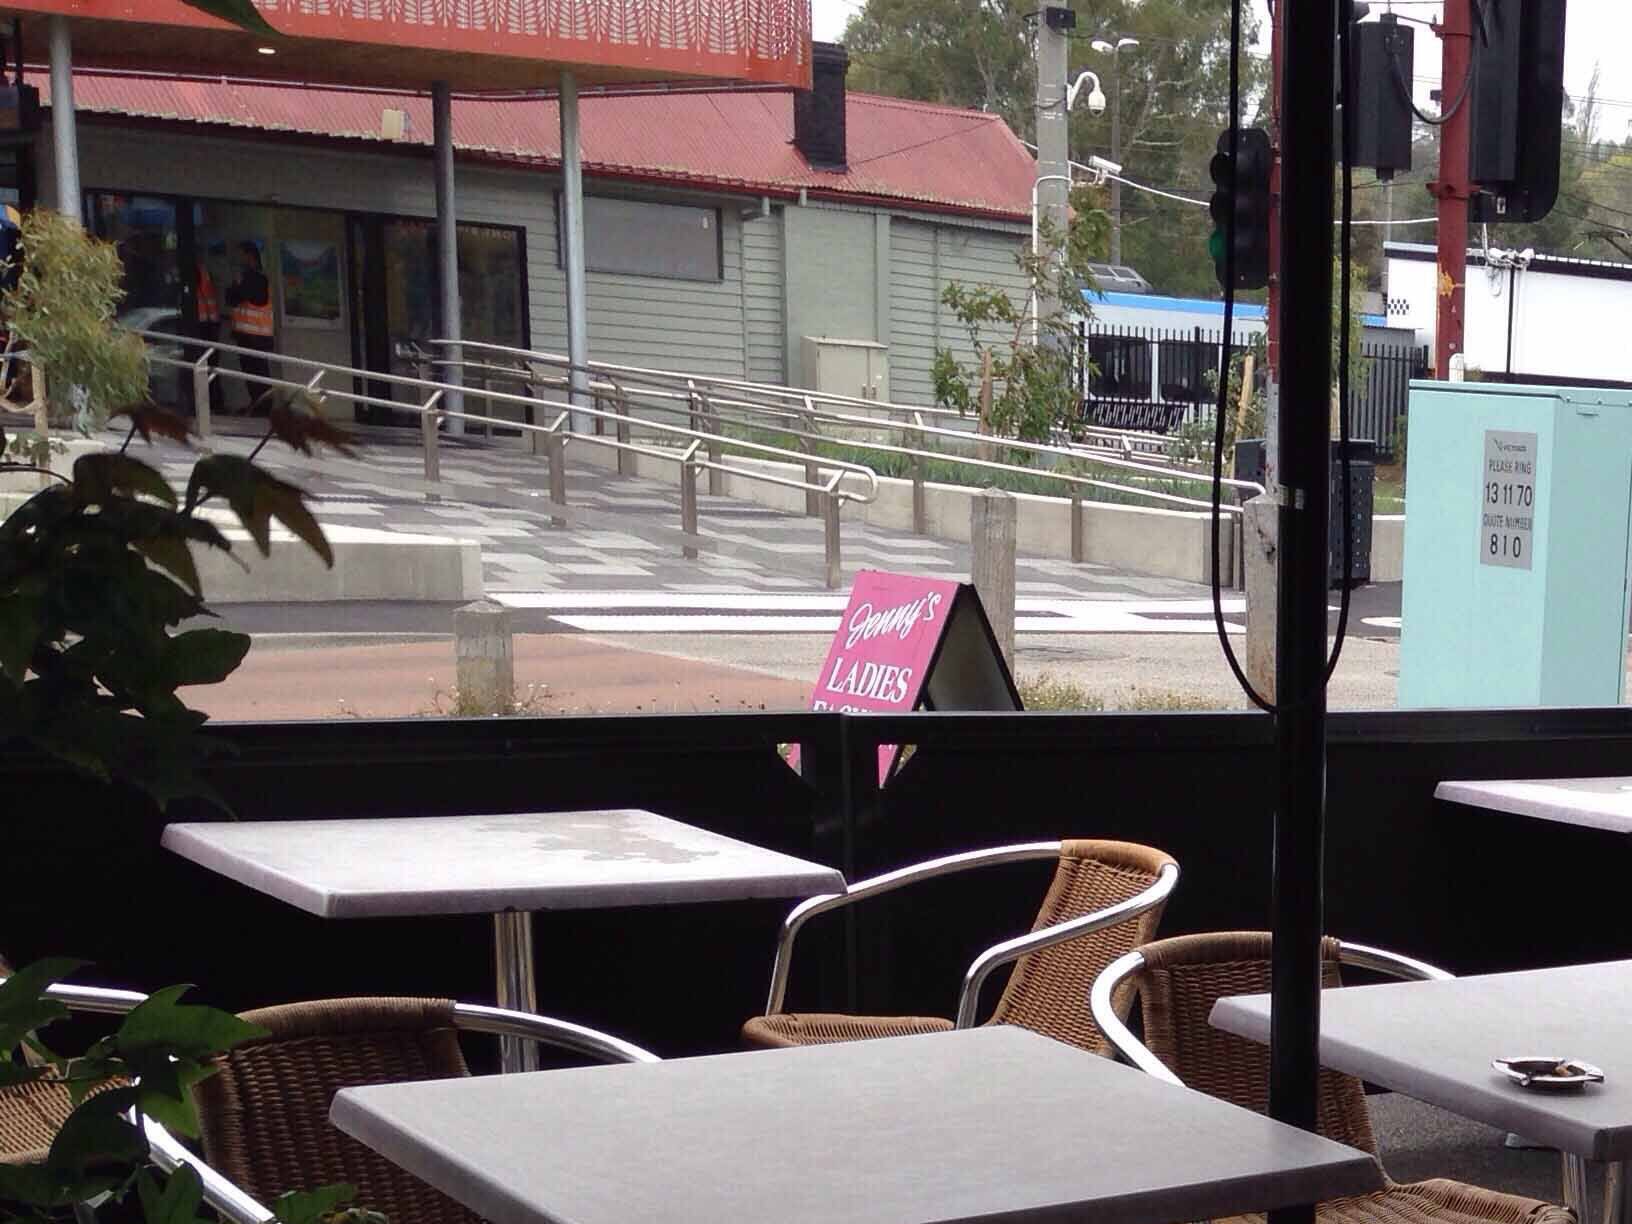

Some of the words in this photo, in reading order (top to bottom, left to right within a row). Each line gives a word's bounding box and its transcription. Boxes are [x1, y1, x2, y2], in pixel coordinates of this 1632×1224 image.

[1488, 459, 1512, 473] PLEASE
[1515, 461, 1531, 475] RING
[1485, 482, 1499, 504] 13
[1503, 483, 1513, 505] 11
[1517, 485, 1532, 507] 70
[1482, 513, 1503, 528] QUOTE
[1505, 515, 1532, 530] NUMBER
[845, 591, 942, 650] Jenny's
[826, 657, 912, 703] LADIES
